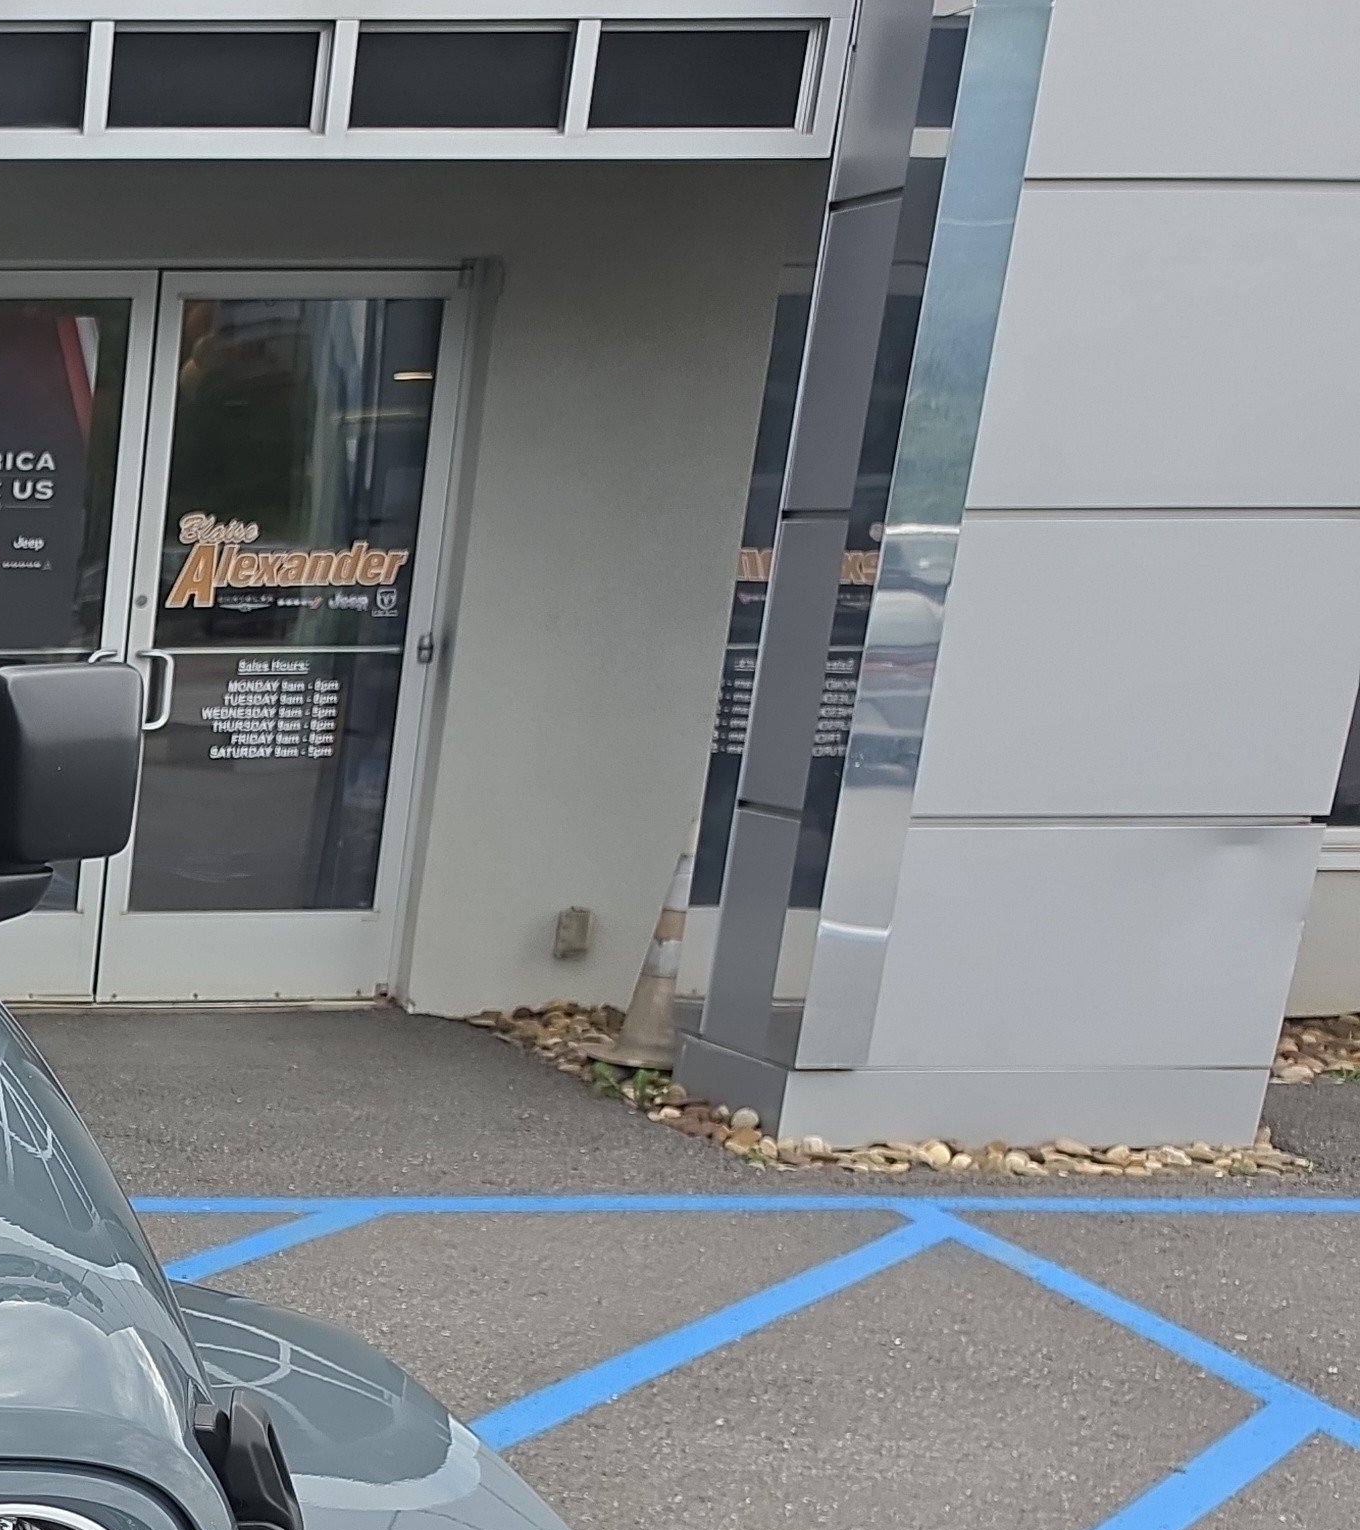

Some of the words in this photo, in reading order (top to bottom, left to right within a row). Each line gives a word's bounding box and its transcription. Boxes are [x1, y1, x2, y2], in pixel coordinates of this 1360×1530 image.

[12, 480, 55, 500] US
[179, 511, 260, 544] Blaise
[165, 540, 410, 608] Alexander
[228, 680, 280, 692] MONDAY
[223, 693, 278, 706] TUESDAY
[201, 706, 277, 719] WEDNESDAY
[212, 719, 276, 732] THURSDAY
[230, 733, 274, 745] FRIDAY
[209, 746, 273, 759] SATURDAY
